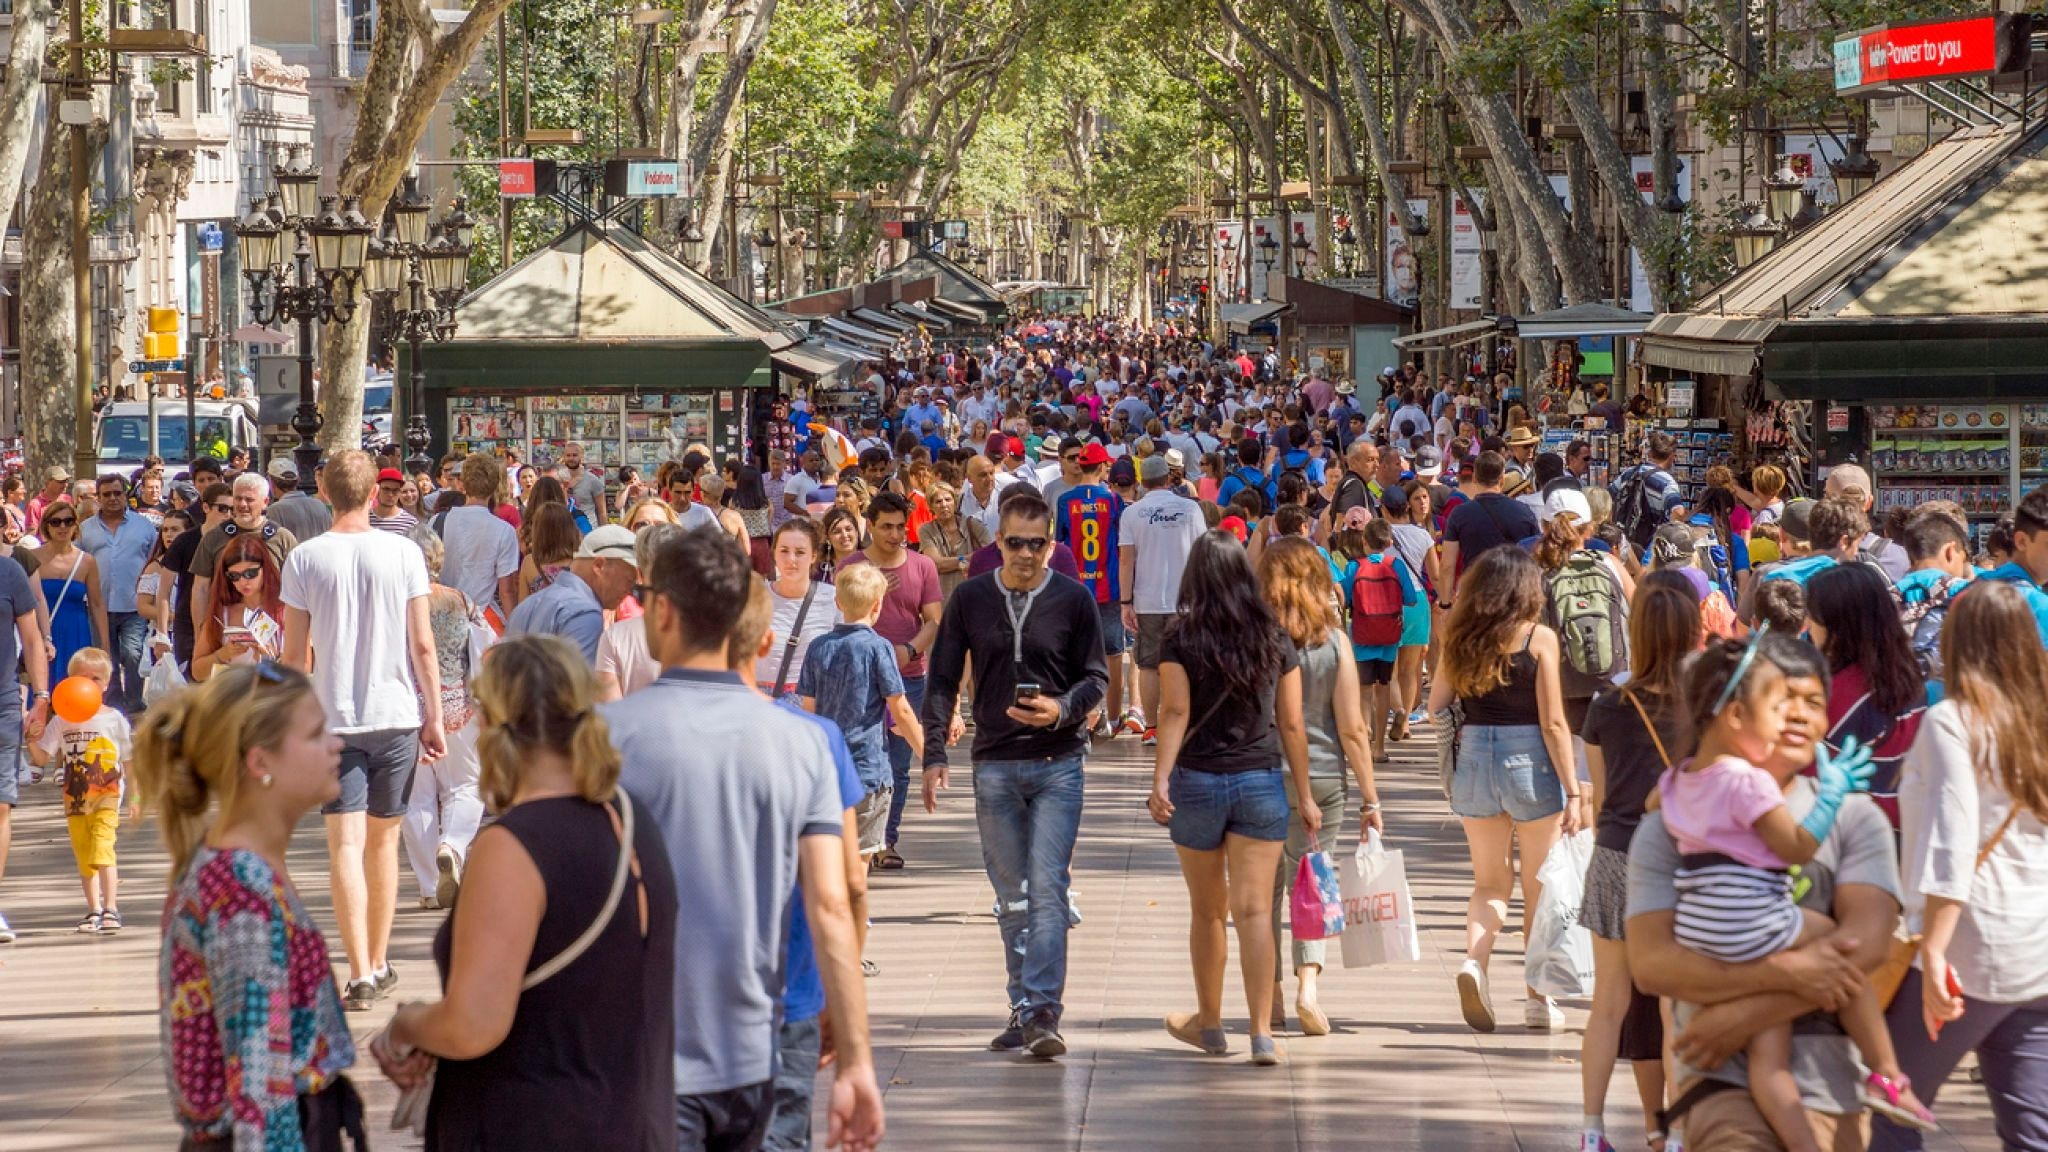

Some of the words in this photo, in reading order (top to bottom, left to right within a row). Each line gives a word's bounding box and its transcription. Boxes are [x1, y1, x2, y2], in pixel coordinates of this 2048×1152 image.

[1887, 41, 1922, 65] Power
[1924, 39, 1936, 62] to
[1938, 39, 1962, 66] you
[644, 170, 673, 185] Vodafone
[1081, 519, 1100, 562] 8
